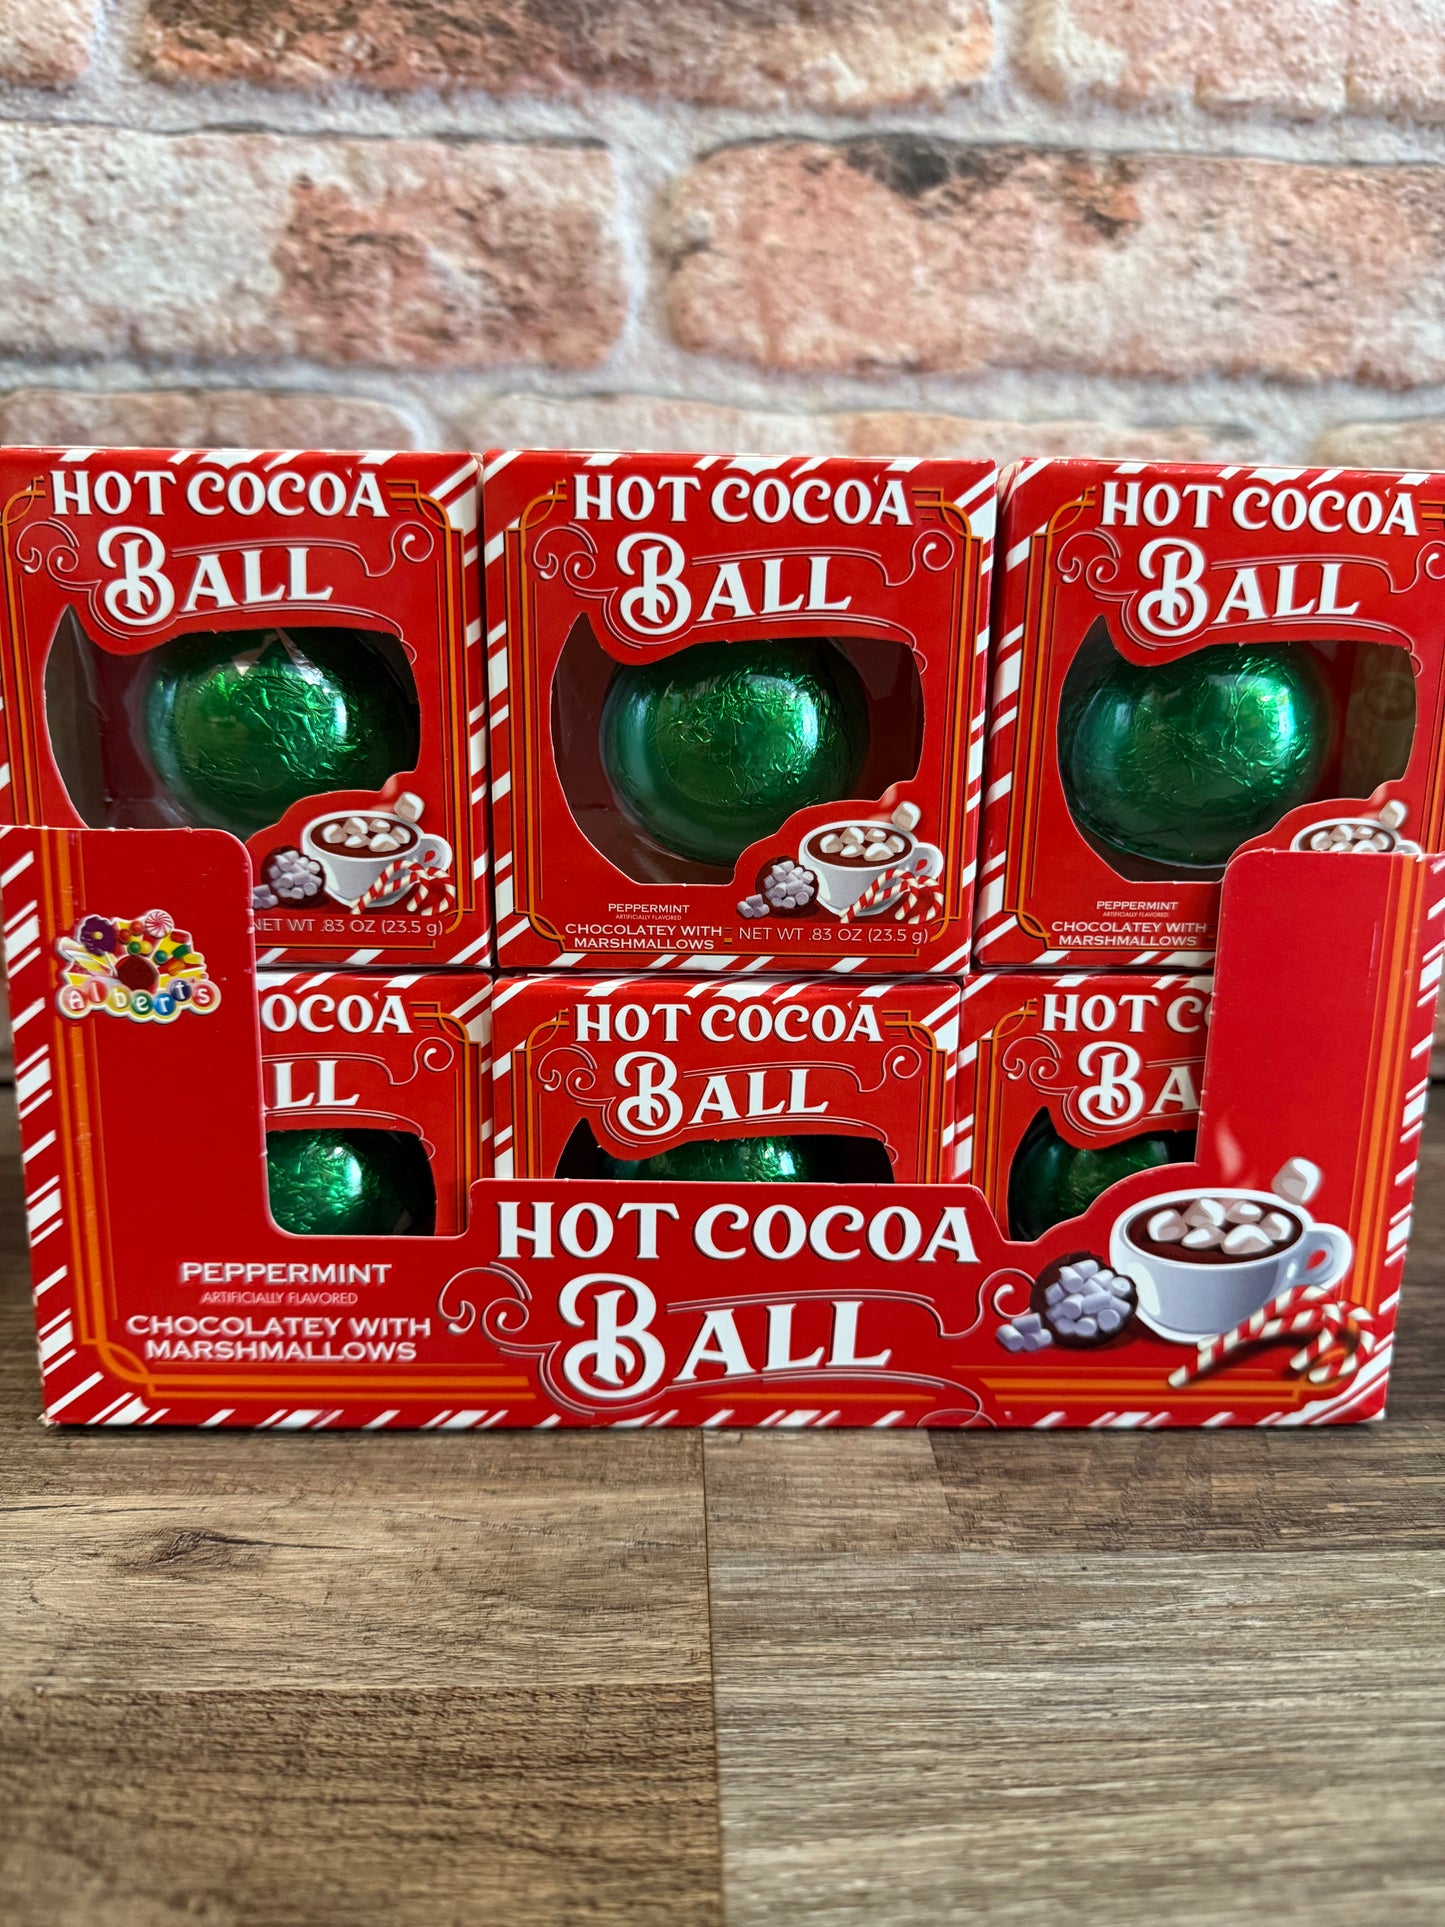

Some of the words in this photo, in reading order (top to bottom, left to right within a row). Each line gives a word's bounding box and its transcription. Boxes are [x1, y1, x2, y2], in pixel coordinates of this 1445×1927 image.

[51, 470, 177, 516] HOT
[187, 471, 390, 517] COCOA
[573, 474, 701, 522] HOT
[711, 478, 913, 526] COCOA
[1102, 481, 1224, 529] HOT
[1232, 488, 1420, 537] COCOA
[97, 526, 334, 626] BALL
[616, 532, 852, 636] BALL
[1138, 538, 1361, 638] BALL
[607, 903, 691, 914] PEPPERMINT
[1096, 901, 1178, 911] PEPPERMINT
[286, 918, 317, 932] WT
[320, 918, 346, 932] .83
[349, 919, 377, 933] OZ
[380, 919, 422, 935] (23.5
[425, 920, 444, 936] g)
[565, 923, 677, 936] CHOCOLATEY
[679, 925, 723, 938] WITH
[573, 936, 715, 950] MARSHMALLOWS
[738, 926, 775, 941] NET
[777, 926, 805, 941] WT
[808, 926, 832, 942] .83
[837, 927, 863, 943] OZ
[867, 927, 907, 943] (23.5
[911, 928, 929, 945] g)
[1051, 921, 1163, 933] CHOCOLATEY
[1165, 922, 1207, 934] WITH
[1058, 935, 1199, 947] MARSHMALLOWS
[67, 977, 214, 1015] Albert's
[260, 993, 414, 1034] OCOA
[1041, 993, 1160, 1033] HOT
[574, 1003, 691, 1042] HOT
[699, 1003, 884, 1043] COCOA
[272, 1060, 361, 1109] LL
[613, 1051, 829, 1136] BALL
[1076, 1040, 1202, 1126] BA
[497, 1201, 679, 1260] HOT
[693, 1203, 980, 1264] COCOA
[180, 1261, 393, 1286] PEPPERMINT
[201, 1290, 284, 1304] ARTIFICIALLY
[287, 1291, 359, 1305] FLAVORED
[125, 1314, 342, 1338] CHOCOLATEY
[347, 1316, 431, 1339] WITH
[559, 1272, 892, 1399] BALL
[145, 1339, 418, 1364] MARSHMALLOWS
